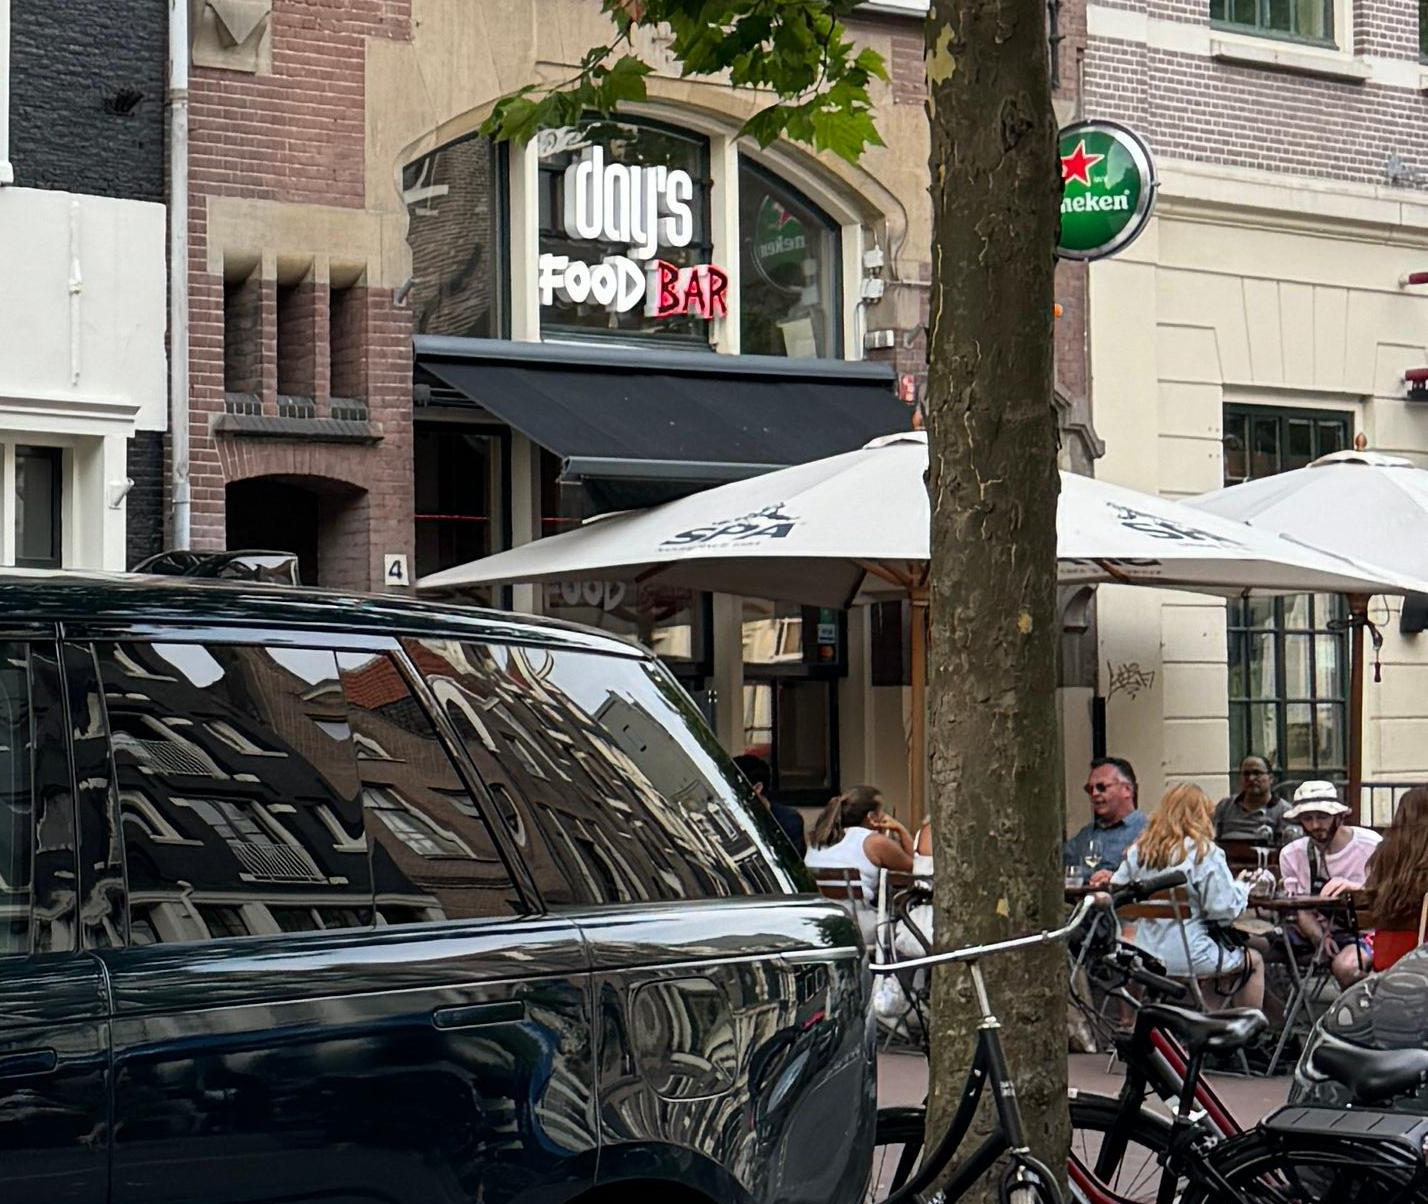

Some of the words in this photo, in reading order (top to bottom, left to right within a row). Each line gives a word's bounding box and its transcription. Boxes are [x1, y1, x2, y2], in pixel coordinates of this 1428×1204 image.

[566, 144, 693, 260] day's
[1060, 191, 1129, 214] neken
[538, 253, 646, 313] FOOD
[654, 258, 729, 320] BAR
[659, 522, 796, 546] SPA
[387, 559, 403, 580] 4
